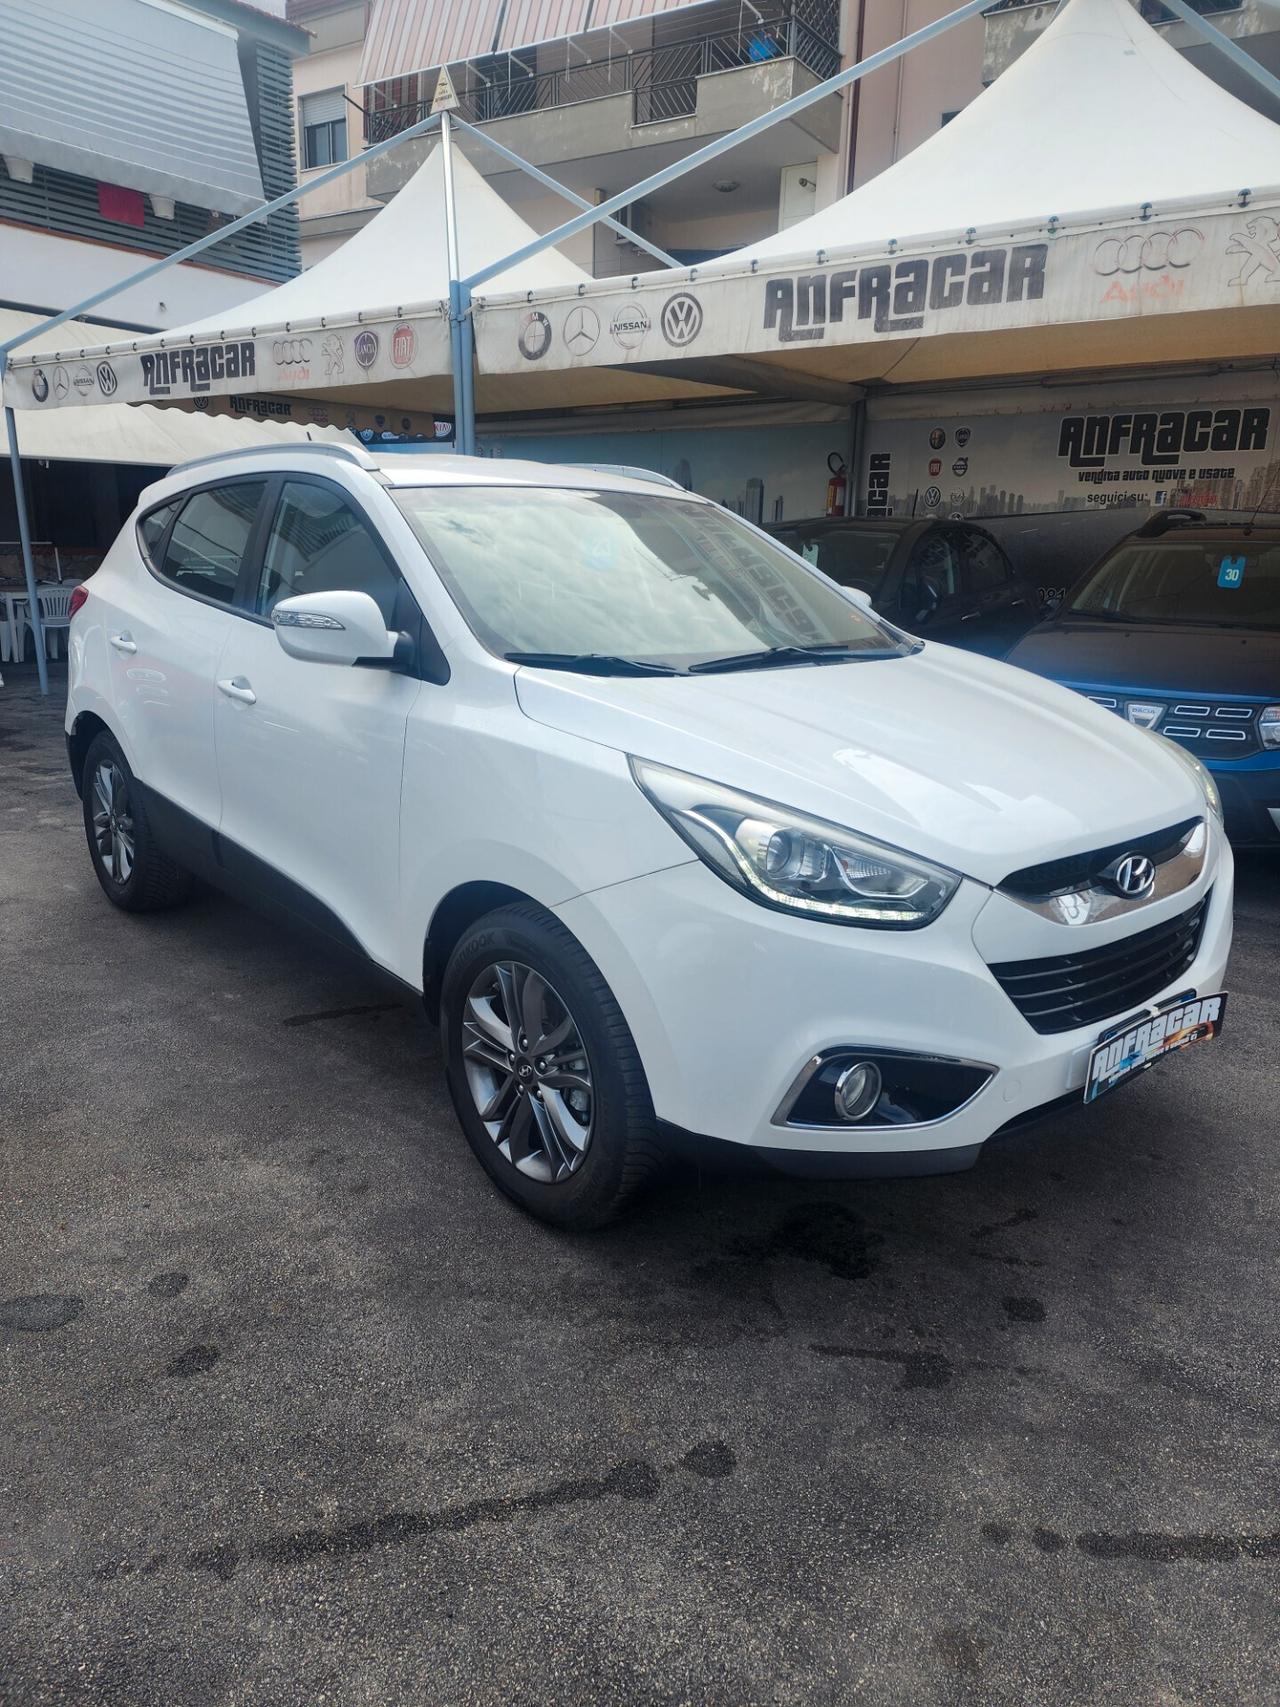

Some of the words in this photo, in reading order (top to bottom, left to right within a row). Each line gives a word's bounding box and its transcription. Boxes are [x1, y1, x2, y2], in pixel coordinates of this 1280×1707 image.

[613, 320, 647, 332] NISSAN
[395, 336, 411, 361] FIAT
[1078, 469, 1120, 484] vendita
[1122, 470, 1149, 481] auto
[1152, 468, 1185, 483] nuove
[1199, 467, 1235, 479] usate
[1087, 491, 1127, 505] seguici
[1225, 569, 1239, 581] 30
